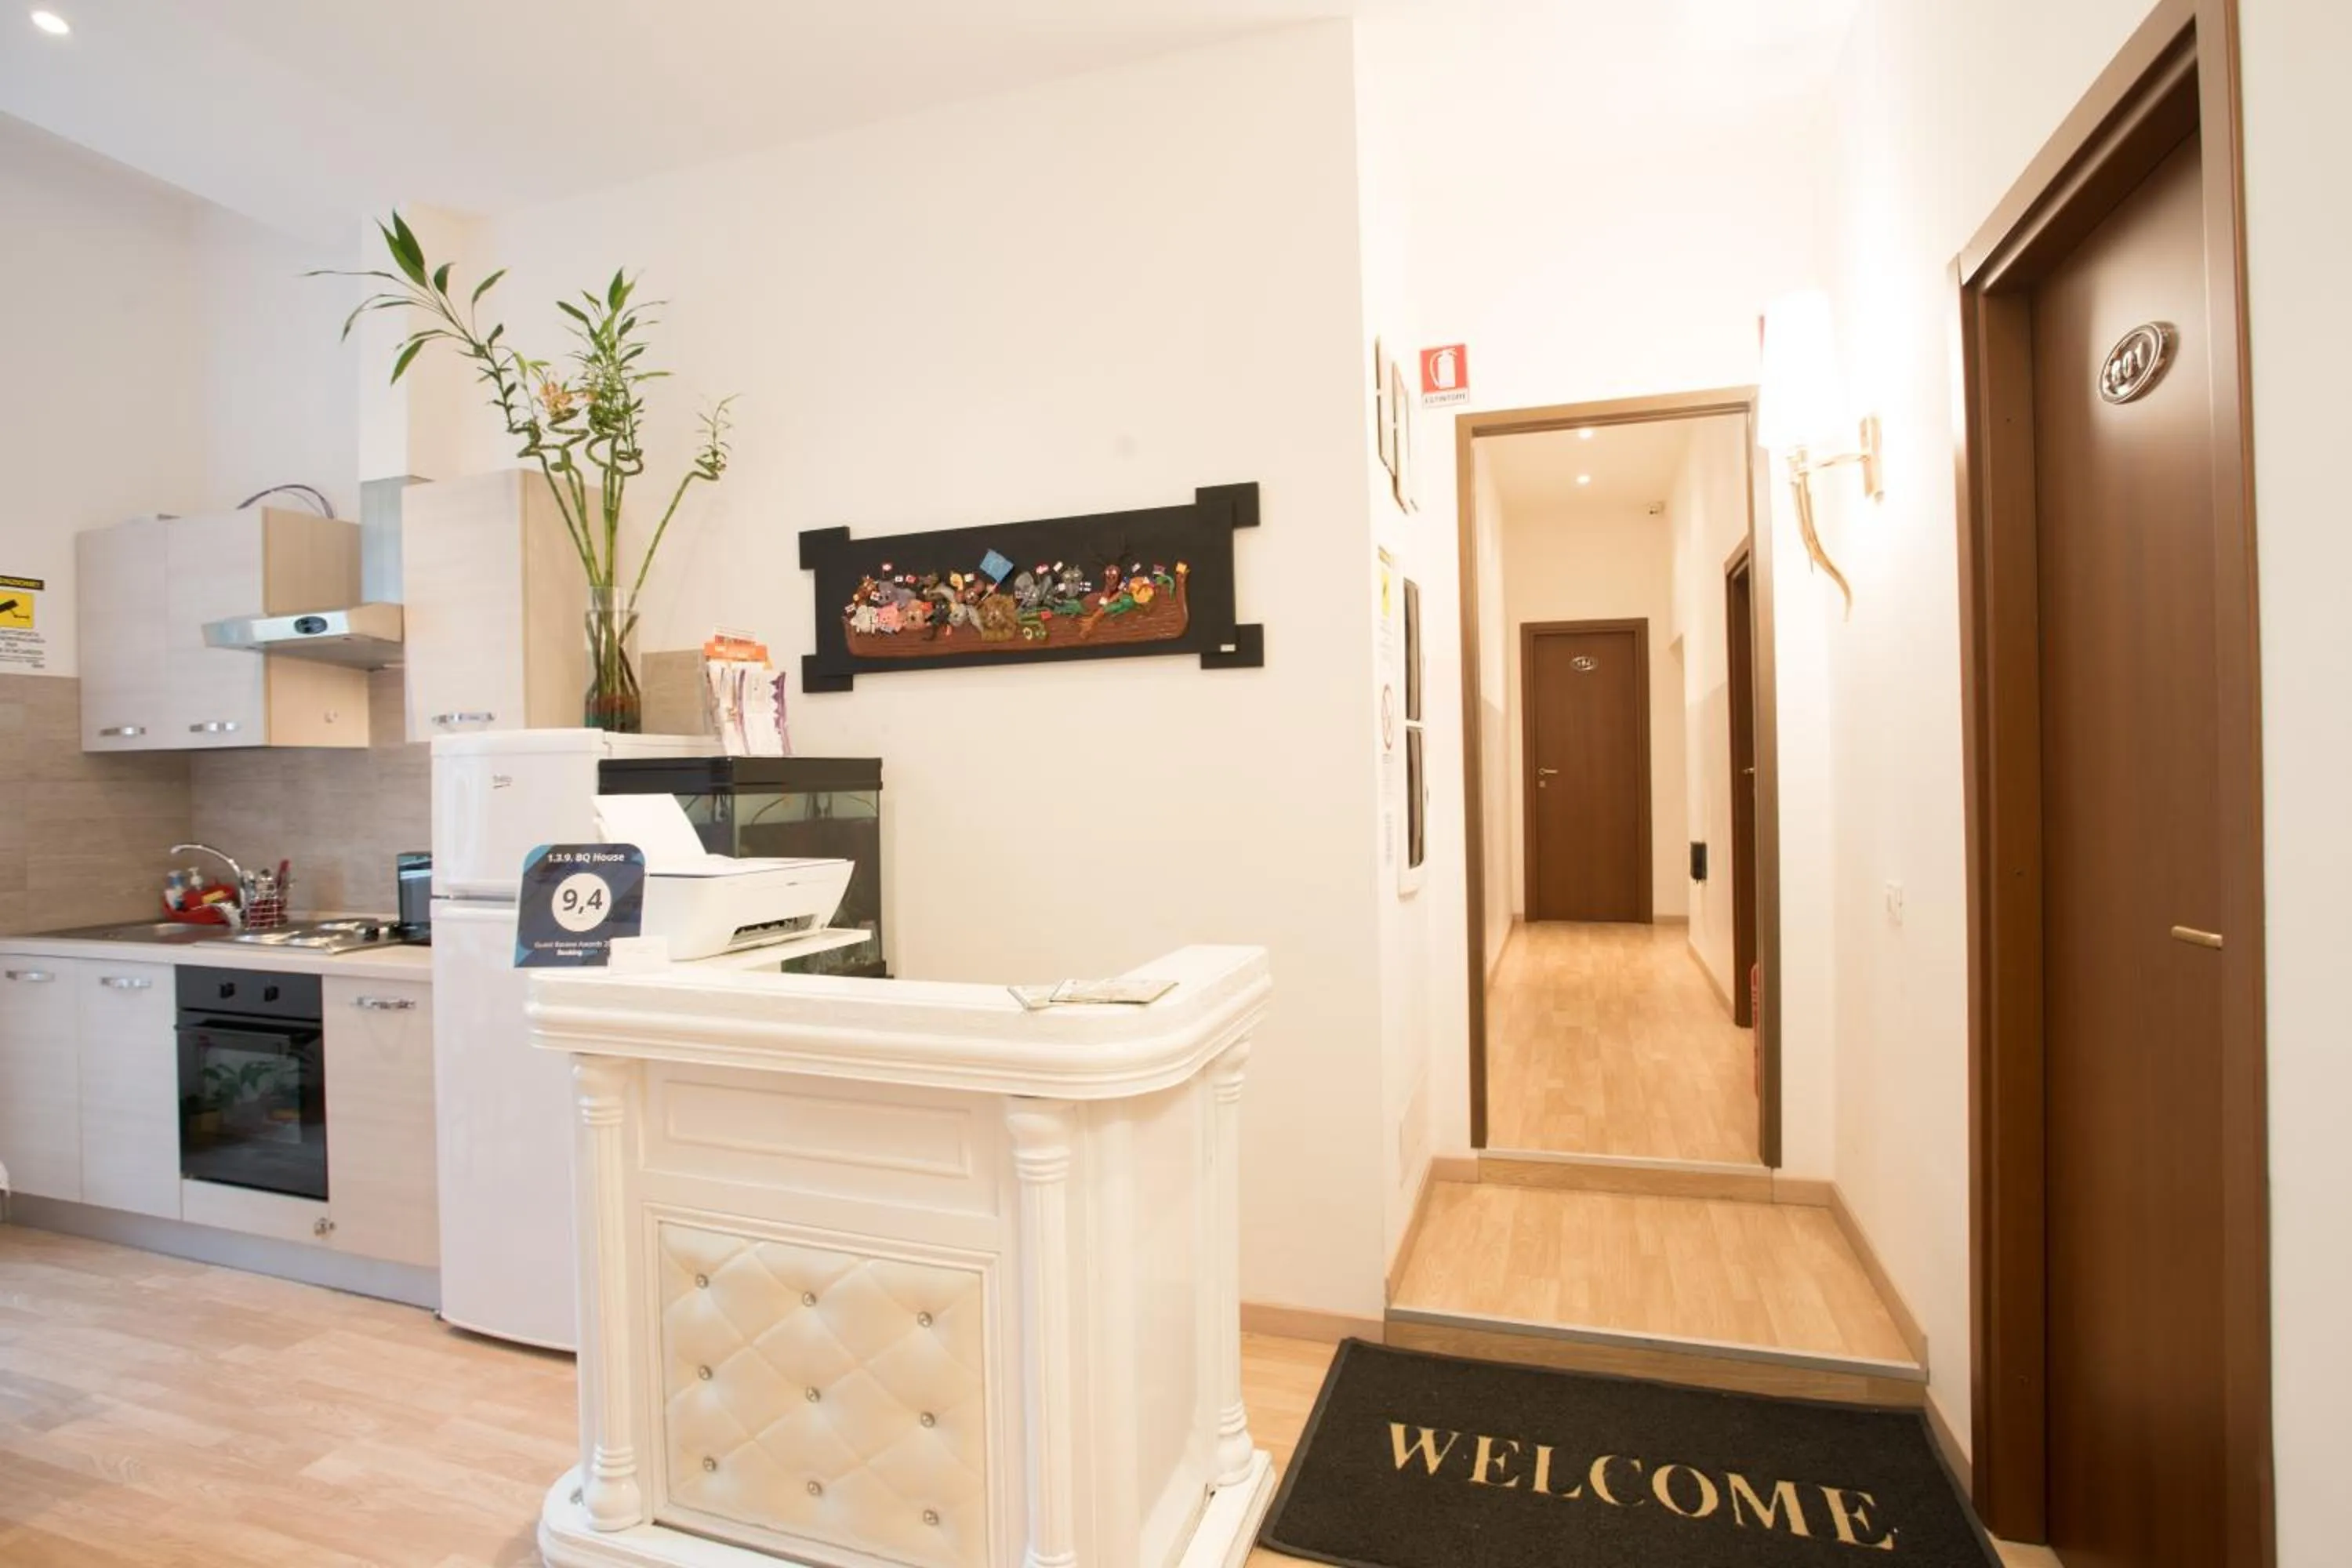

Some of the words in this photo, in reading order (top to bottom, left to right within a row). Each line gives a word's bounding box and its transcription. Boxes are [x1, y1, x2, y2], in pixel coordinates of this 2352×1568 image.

[593, 851, 626, 862] House
[562, 888, 603, 915] 9,4
[1387, 1421, 1895, 1551] WELCOME
